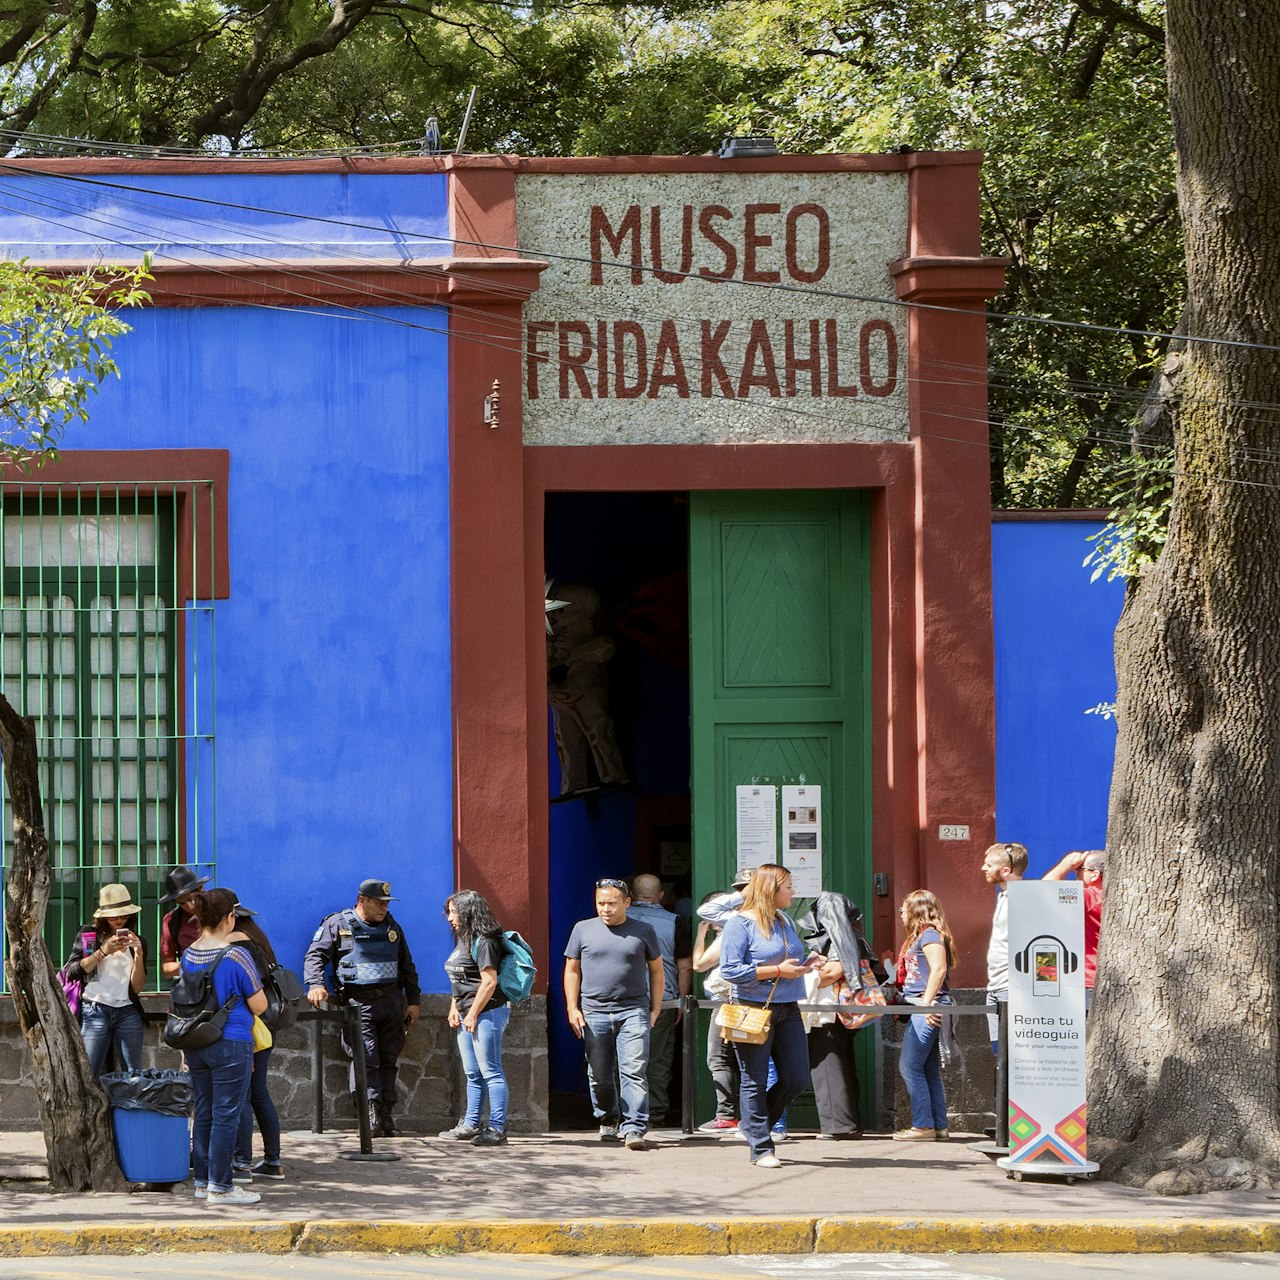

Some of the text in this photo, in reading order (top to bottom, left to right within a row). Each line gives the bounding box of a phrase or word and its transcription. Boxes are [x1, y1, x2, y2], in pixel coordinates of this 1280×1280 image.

[589, 203, 830, 285] MUSEO
[526, 319, 897, 399] FRIDA KAHLO
[943, 827, 967, 838] 247
[1014, 1014, 1072, 1026] Renta tu
[1014, 1028, 1078, 1042] videoguía
